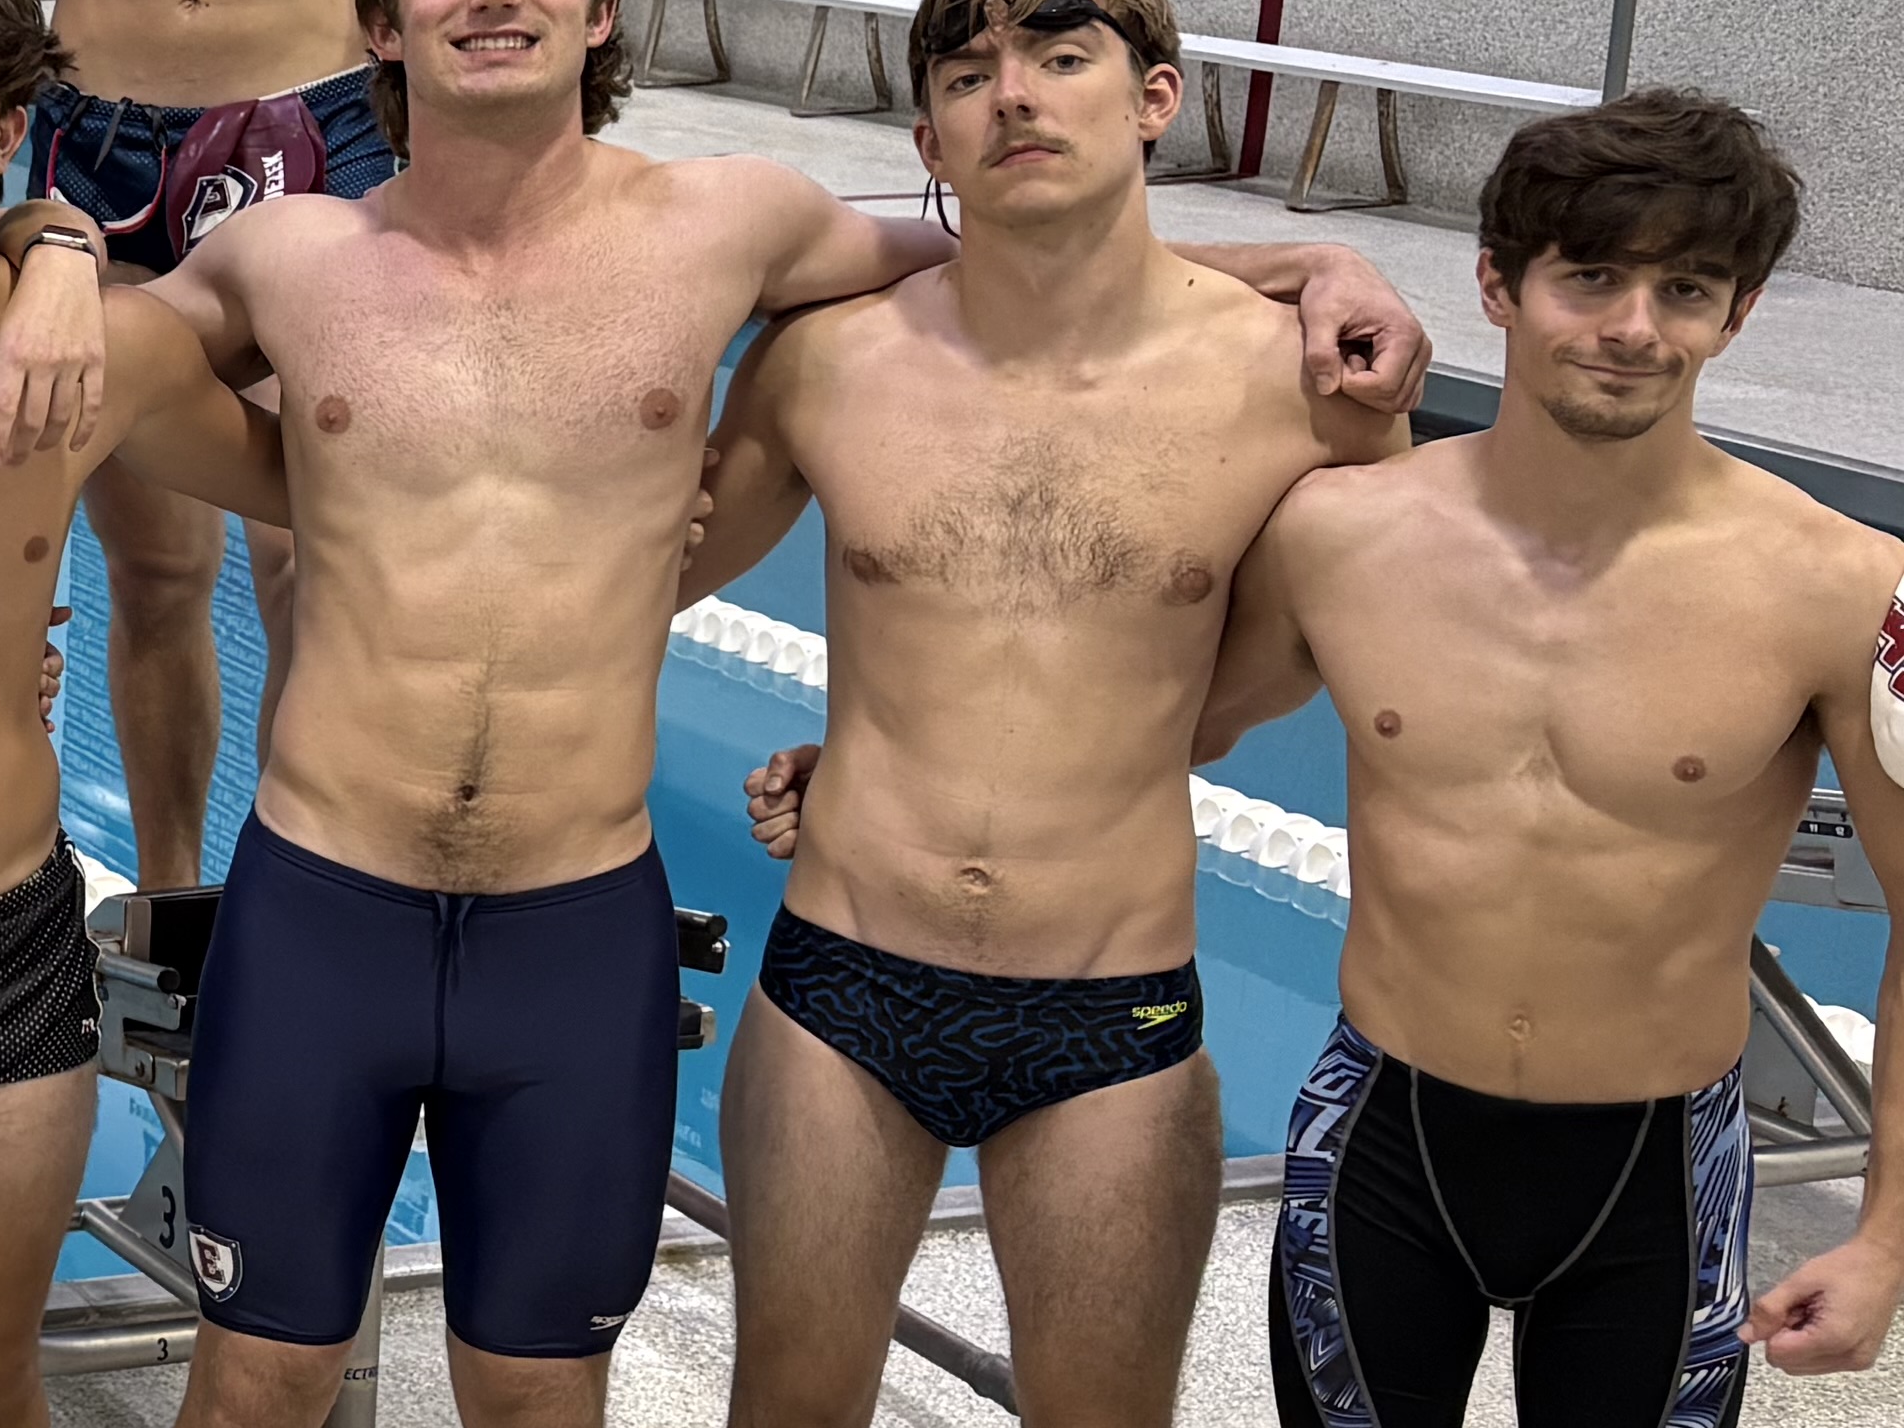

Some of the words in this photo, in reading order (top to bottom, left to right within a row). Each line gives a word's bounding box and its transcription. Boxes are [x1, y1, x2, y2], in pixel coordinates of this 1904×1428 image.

[1132, 1000, 1187, 1019] speedo
[159, 1185, 176, 1249] 3
[195, 1235, 227, 1286] E
[157, 1338, 169, 1361] 3
